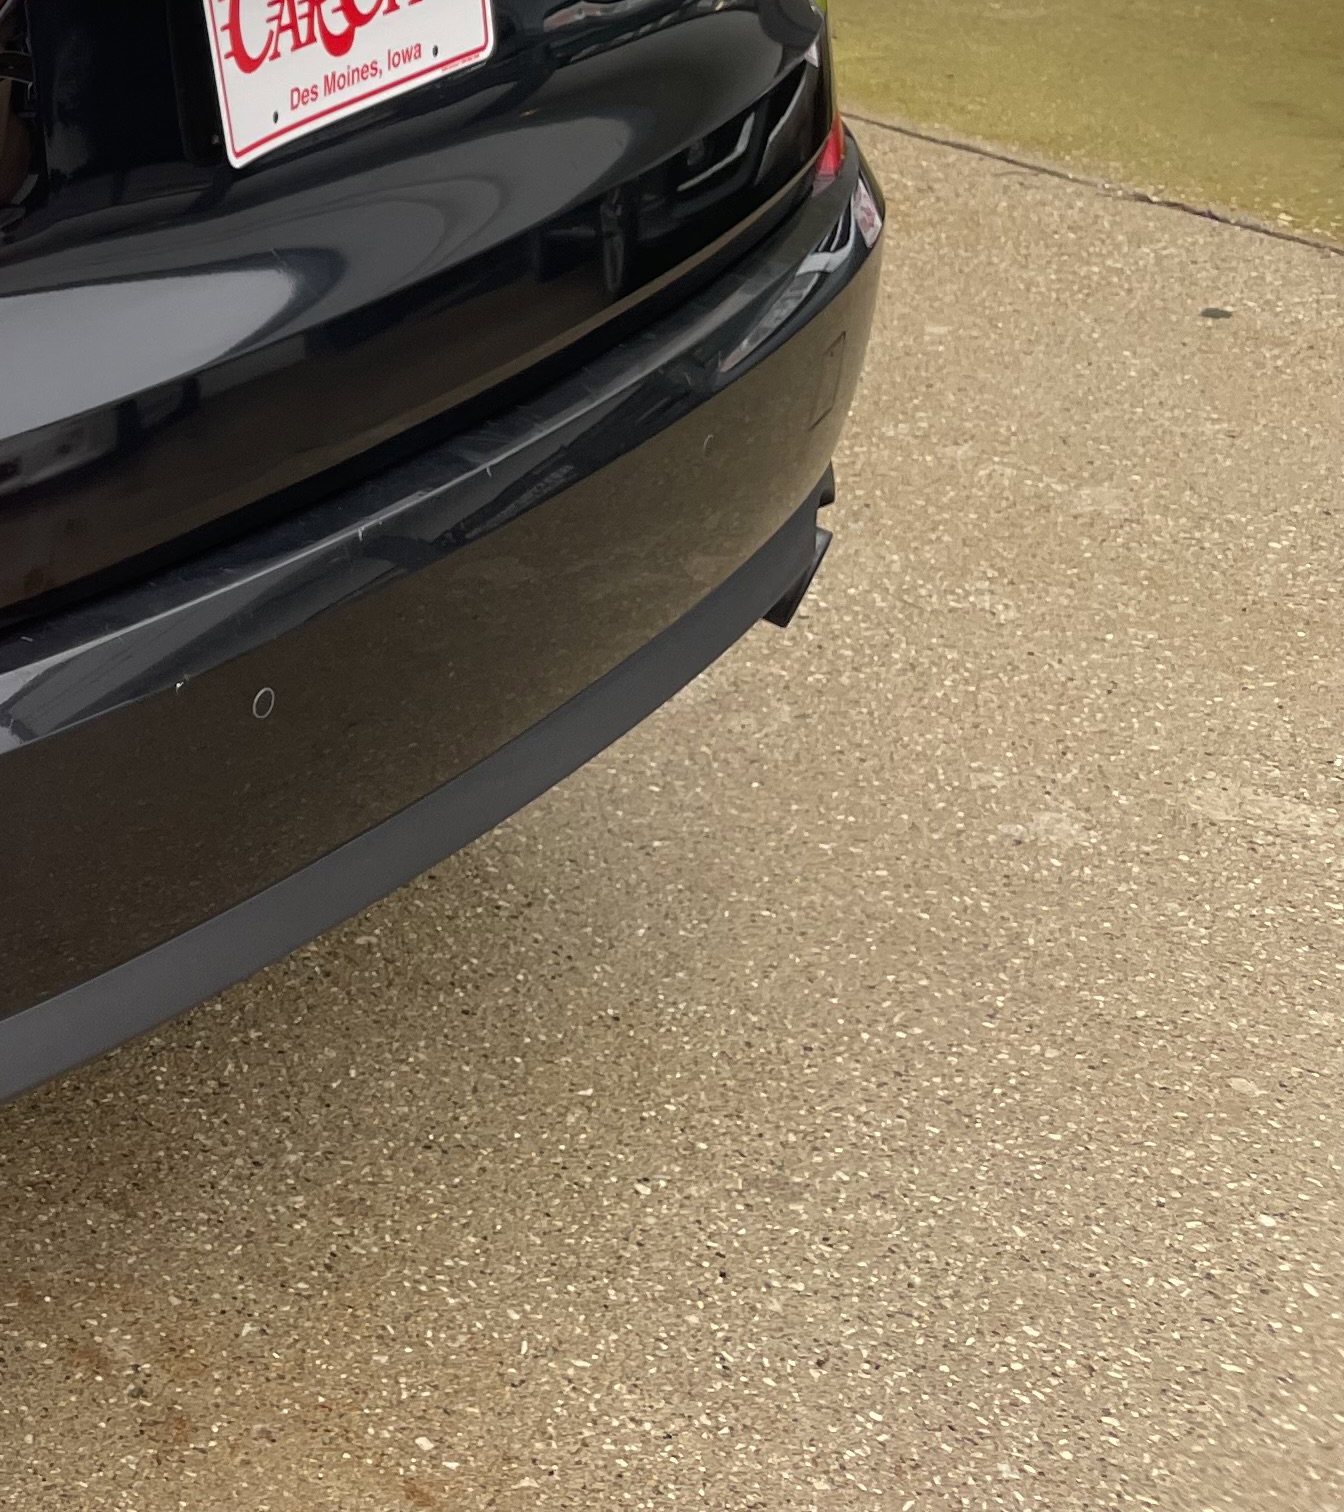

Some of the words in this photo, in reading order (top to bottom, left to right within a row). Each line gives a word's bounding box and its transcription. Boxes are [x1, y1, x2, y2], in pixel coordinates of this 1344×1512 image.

[290, 85, 318, 111] Des
[323, 61, 383, 96] Moines,
[387, 42, 422, 71] Iowa
